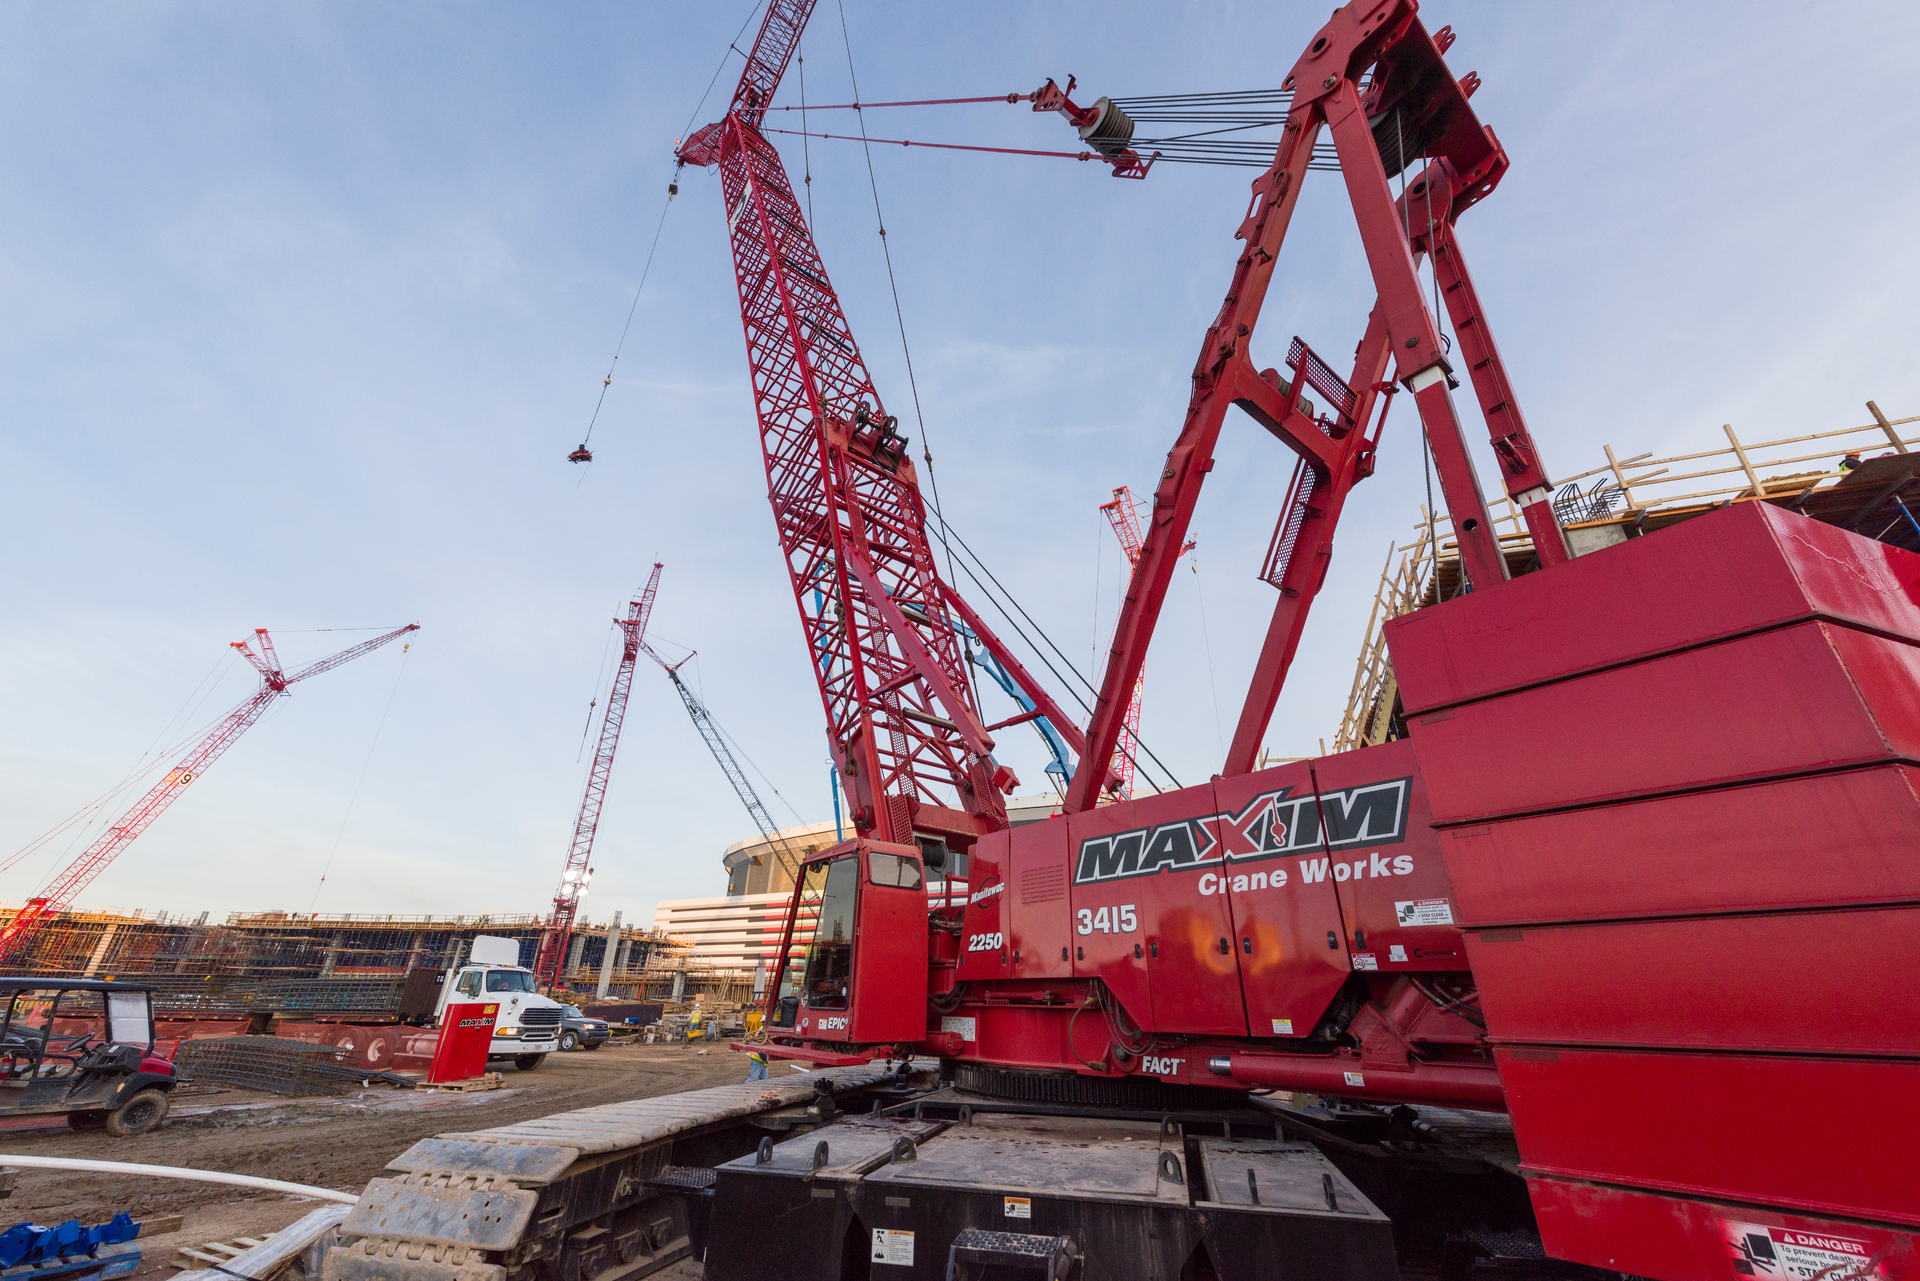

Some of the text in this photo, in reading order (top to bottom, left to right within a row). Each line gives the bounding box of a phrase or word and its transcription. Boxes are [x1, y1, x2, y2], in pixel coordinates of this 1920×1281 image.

[1073, 777, 1410, 885] MAXIM
[1198, 852, 1415, 897] Crane Works
[971, 882, 1005, 905] Manitowoc
[1077, 904, 1138, 936] 3415
[968, 932, 1003, 952] 2250
[459, 1017, 495, 1027] MAXIM
[1780, 1244, 1867, 1266] To prevent death or
[1796, 1234, 1866, 1255] DANGER
[1785, 1255, 1819, 1267] serious
